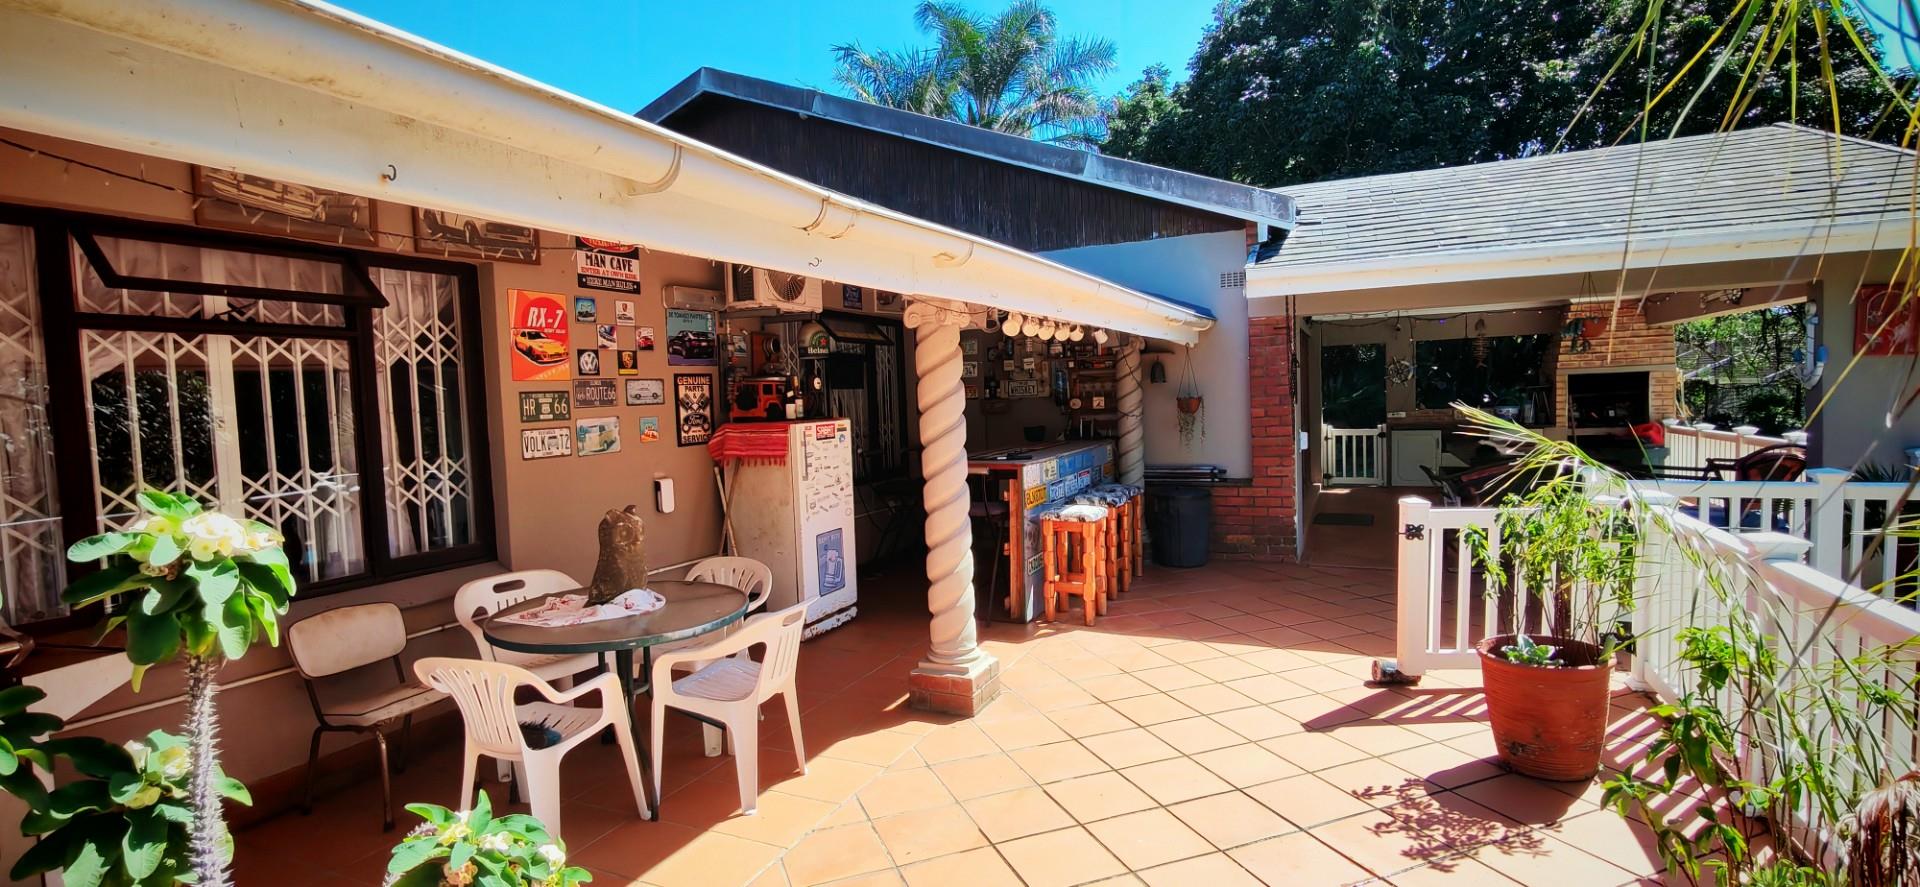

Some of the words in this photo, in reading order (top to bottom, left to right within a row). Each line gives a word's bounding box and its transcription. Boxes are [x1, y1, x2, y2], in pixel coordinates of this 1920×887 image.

[584, 252, 607, 270] MAN
[609, 256, 633, 273] CAVE
[527, 306, 564, 329] RX-7
[677, 376, 711, 385] GENUINE
[684, 385, 705, 393] PARTS
[1010, 384, 1036, 394] WHISKEY
[523, 398, 537, 416] HR
[554, 398, 568, 414] 66
[687, 414, 704, 425] Ford
[523, 435, 548, 453] VOLK
